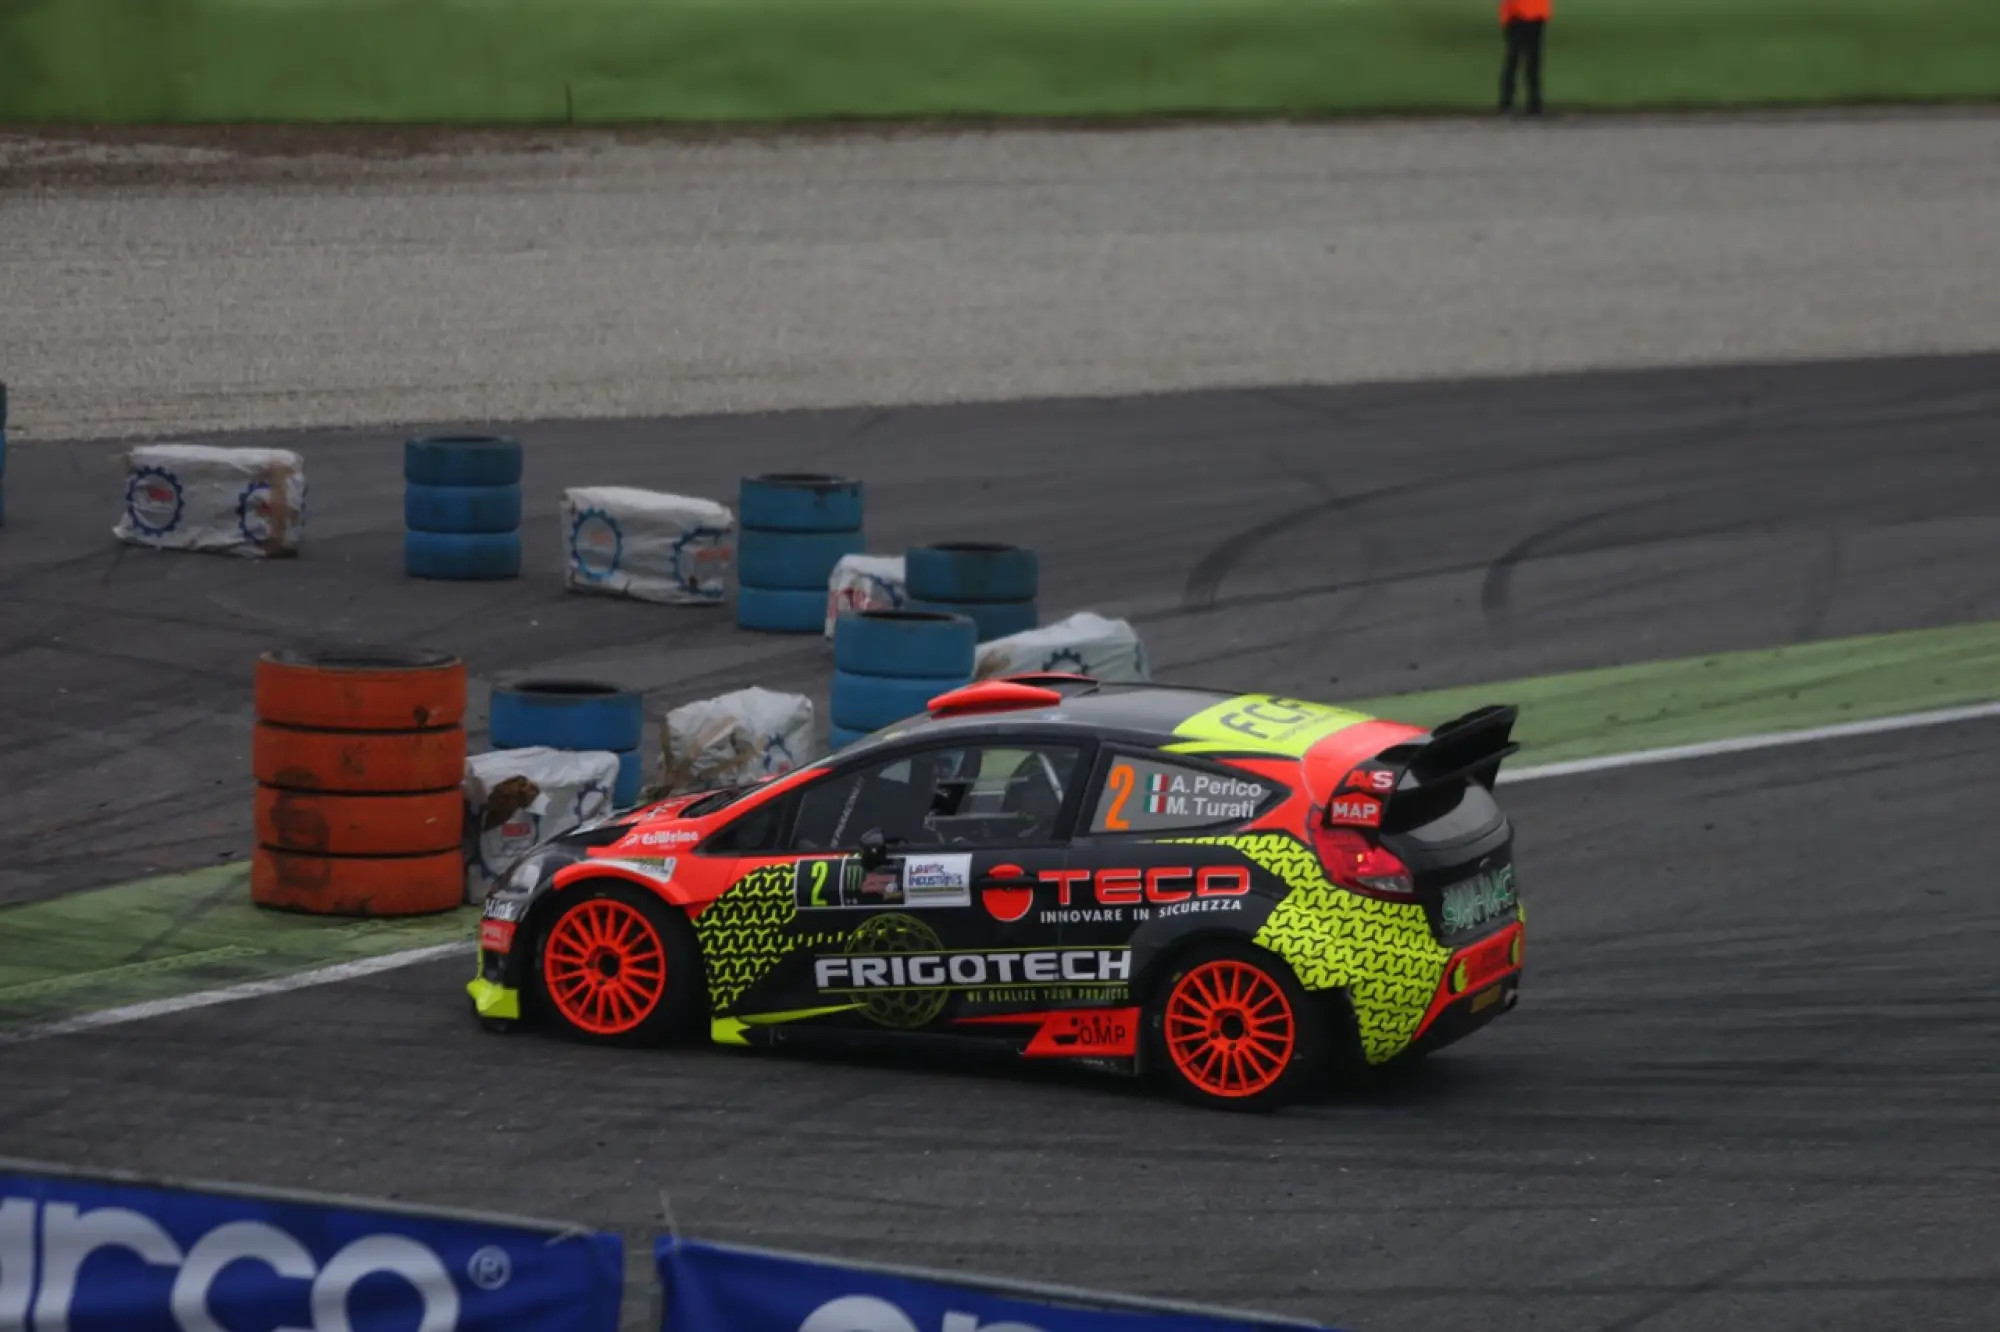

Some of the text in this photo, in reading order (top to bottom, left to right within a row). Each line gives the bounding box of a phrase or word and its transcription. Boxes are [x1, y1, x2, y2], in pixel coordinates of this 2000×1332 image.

[1105, 764, 1135, 830] 2
[1170, 775, 1262, 797] A. Perico
[1167, 796, 1255, 818] M. Turati
[1332, 801, 1378, 818] MAP
[810, 860, 829, 906] 2
[1038, 865, 1250, 905] TECO
[1040, 899, 1242, 924] INNOVARE IN SICUREZZA
[814, 950, 1132, 988] FRIGOTECH
